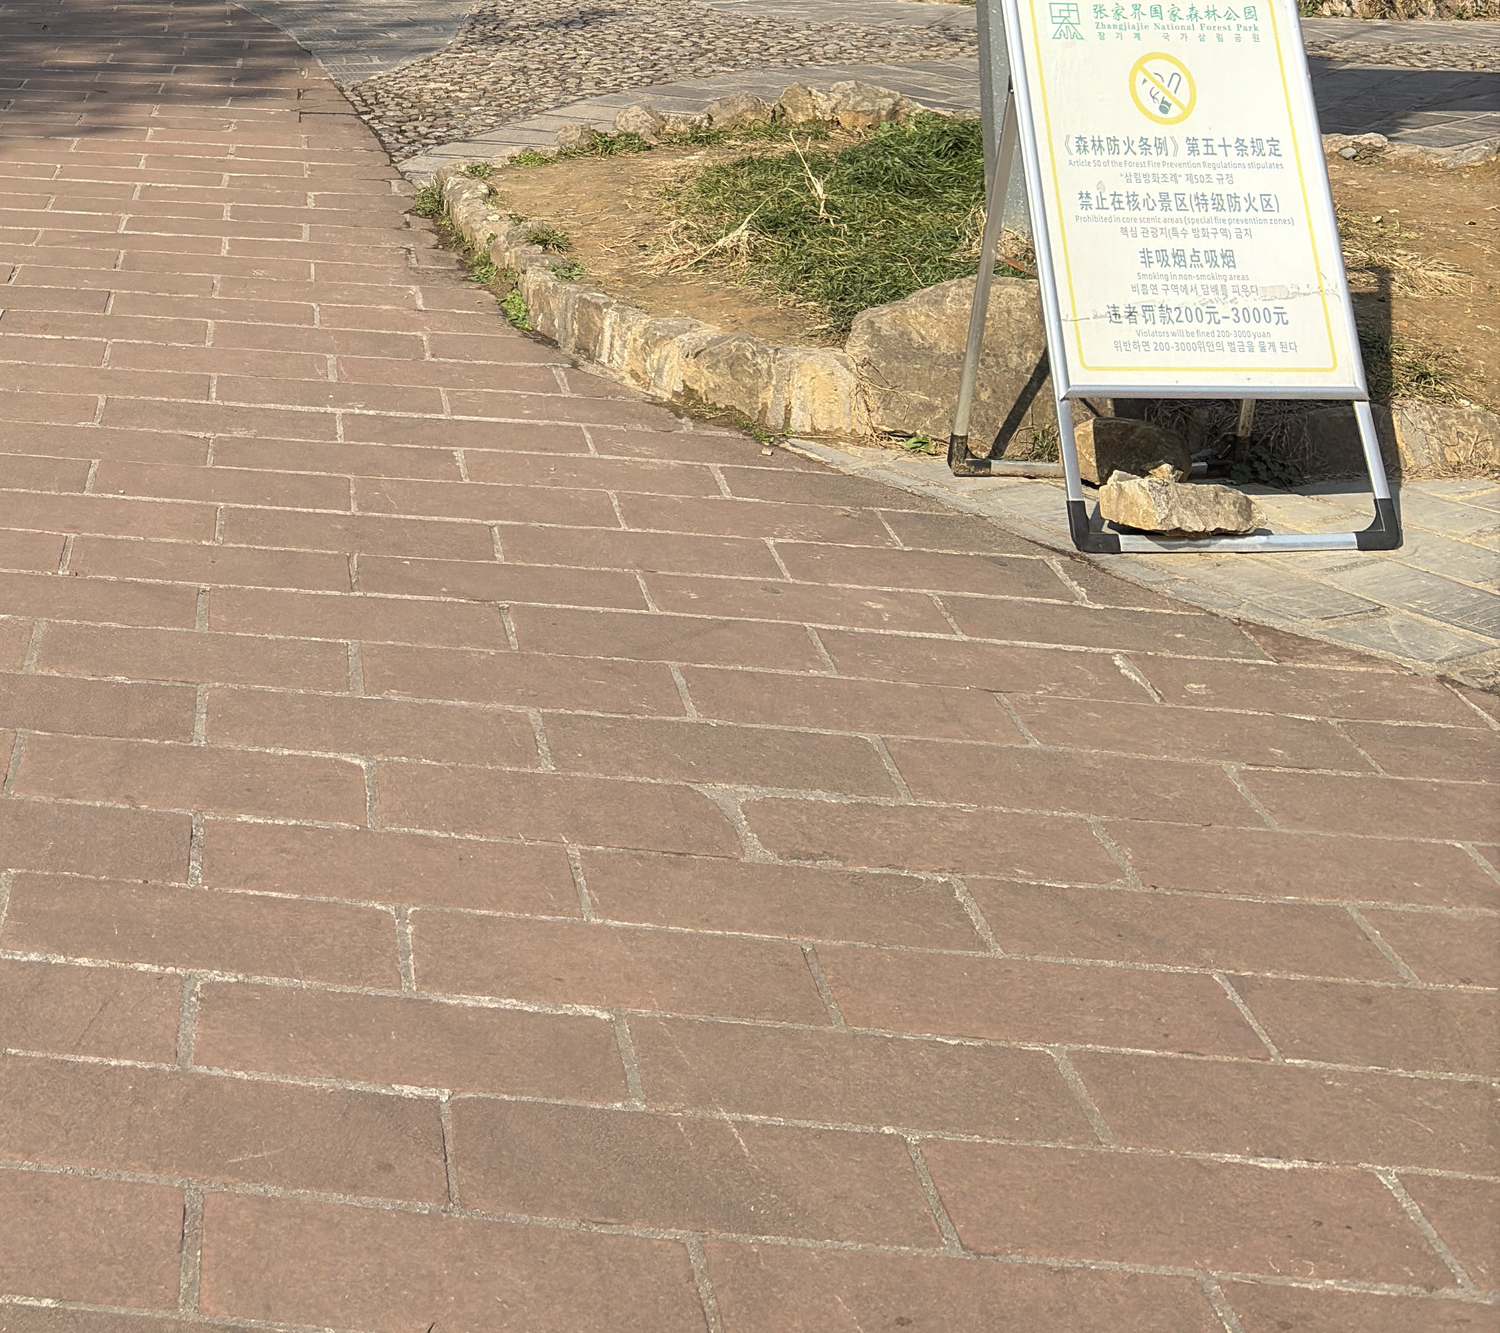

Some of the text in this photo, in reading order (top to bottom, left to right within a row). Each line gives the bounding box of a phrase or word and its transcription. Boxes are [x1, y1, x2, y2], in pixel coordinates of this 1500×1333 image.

[1092, 2, 1259, 24] 张家界国家森林公园
[1094, 21, 1260, 33] Zhangjiajie National Forest Park
[1068, 158, 1284, 172] Article 50 of the Forest Fire Prevention Regulations stipulates
[1075, 214, 1295, 228] Prohibited in core scenic areas (special fire prevention zones)
[1138, 247, 1237, 270] 非吸烟点吸烟
[1137, 272, 1250, 284] Smoking in non-smoking areas
[1135, 329, 1272, 341] Violators will be fined 200-3000 yuan
